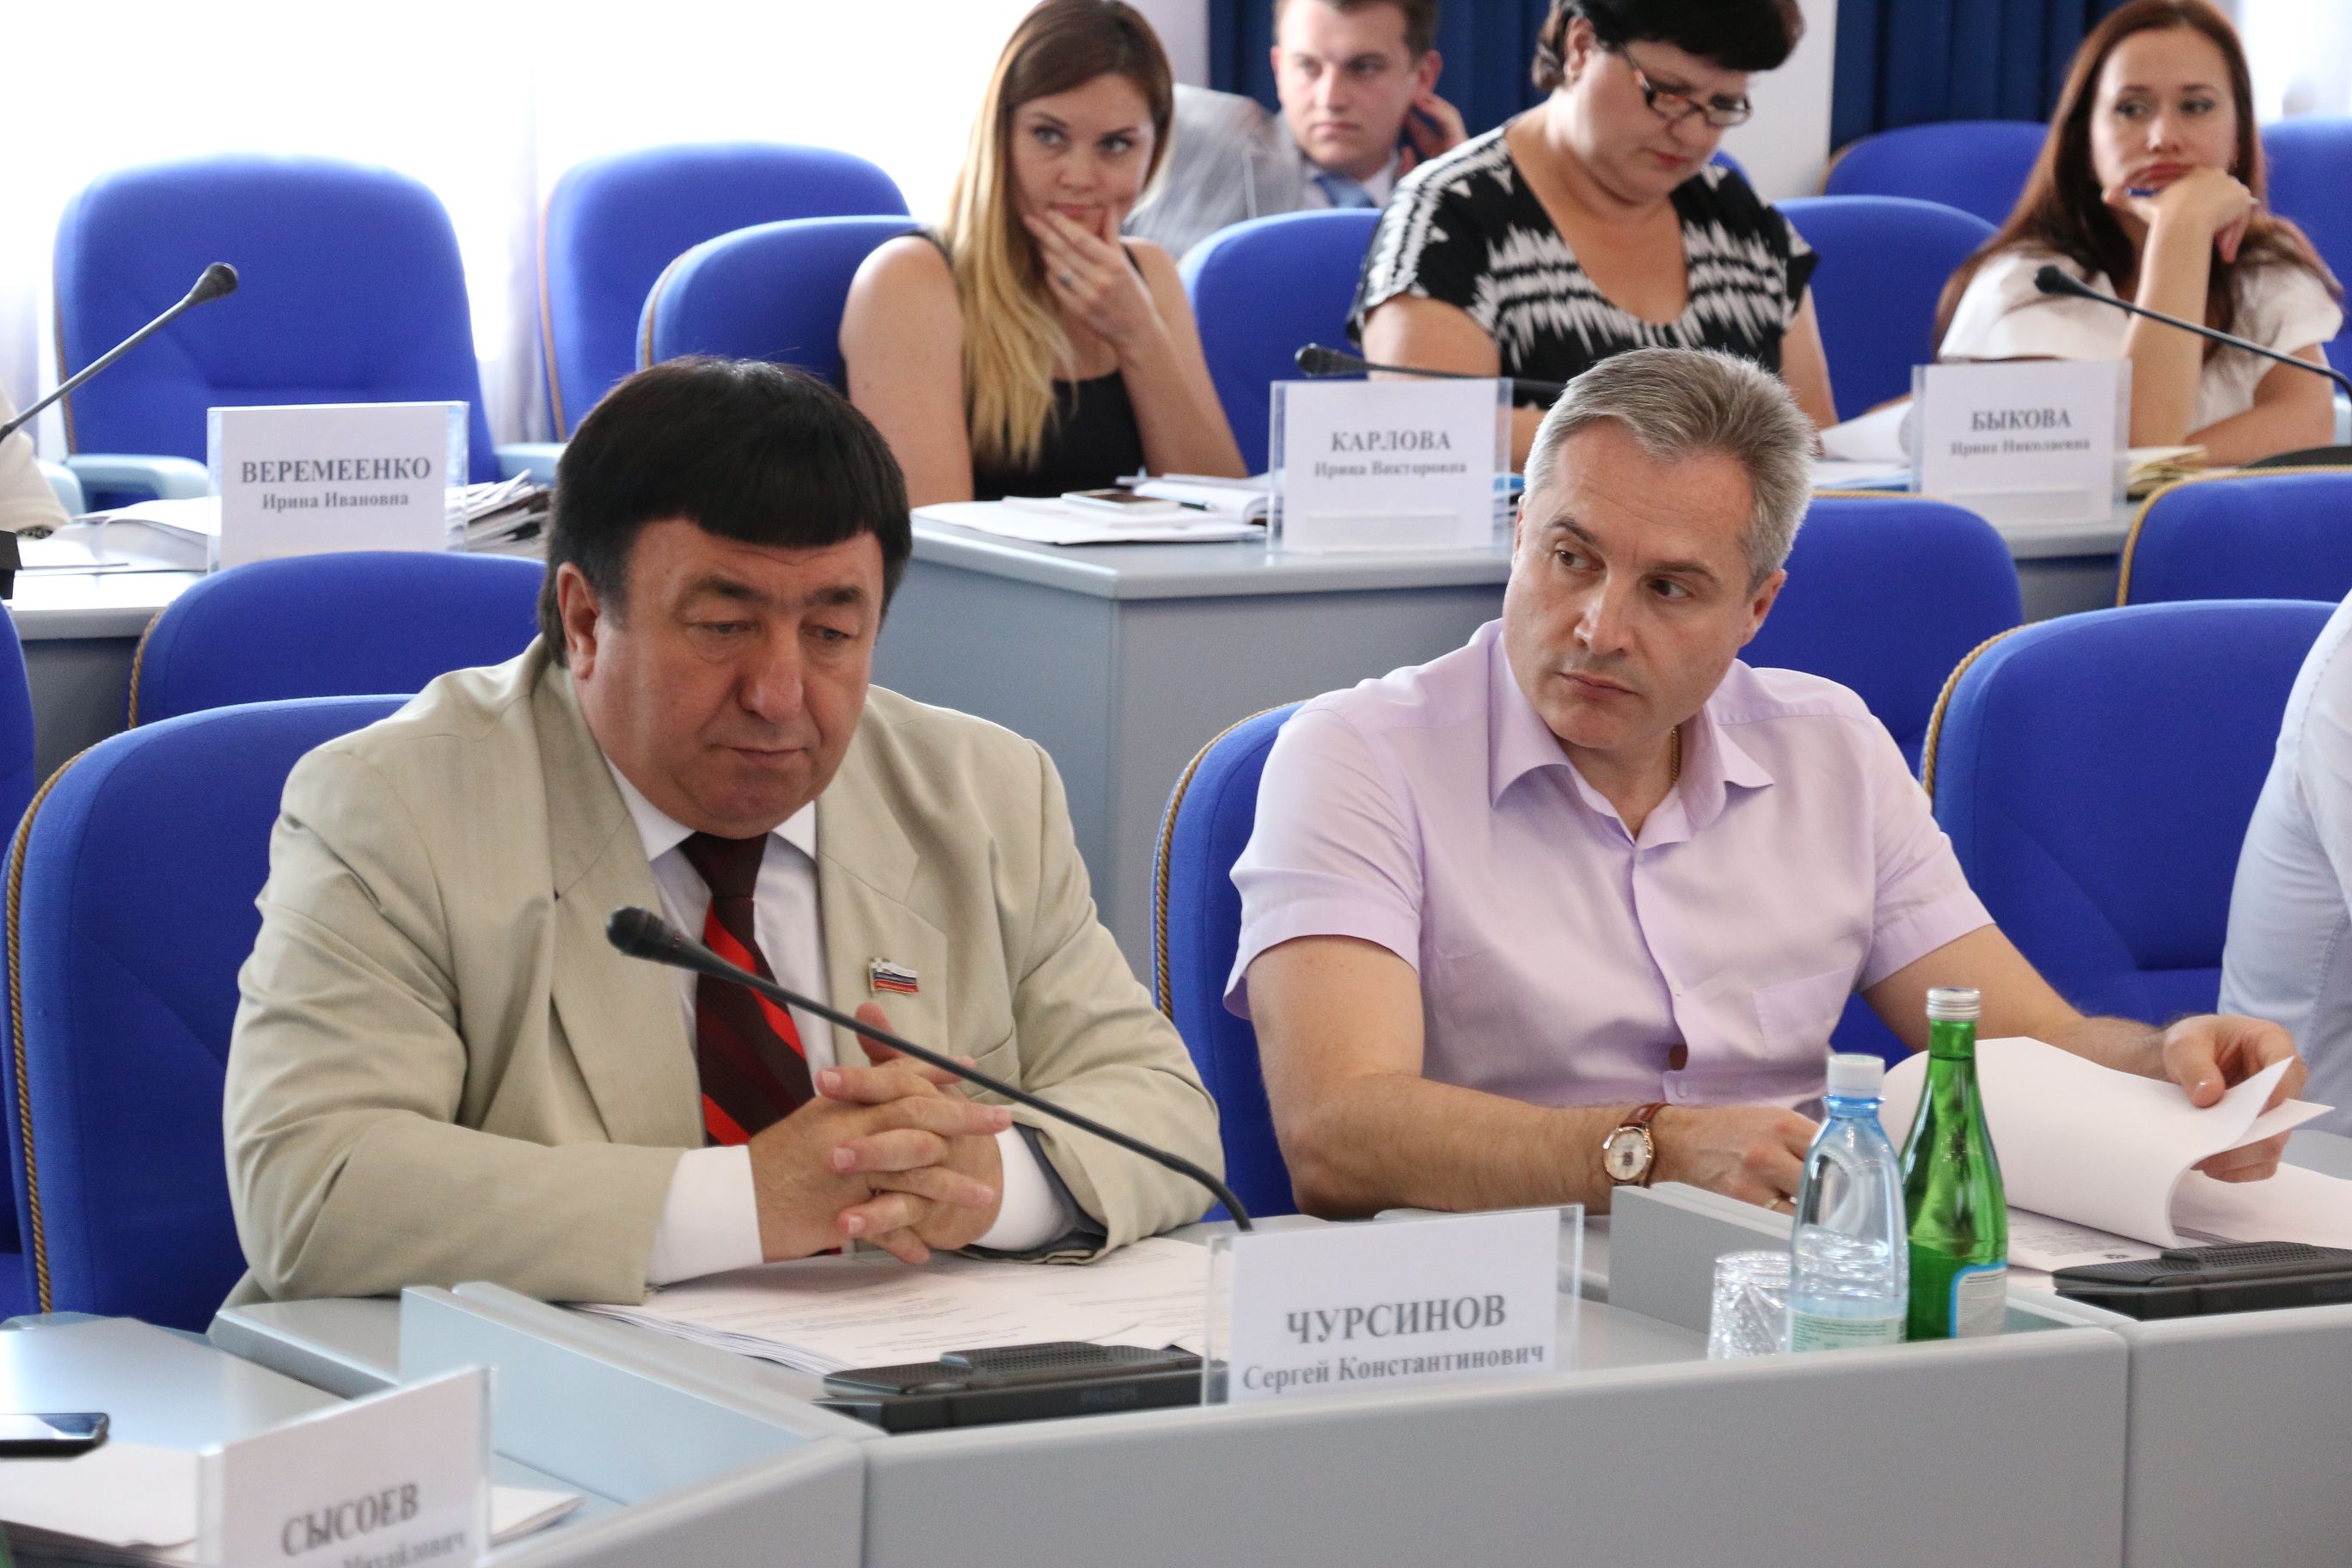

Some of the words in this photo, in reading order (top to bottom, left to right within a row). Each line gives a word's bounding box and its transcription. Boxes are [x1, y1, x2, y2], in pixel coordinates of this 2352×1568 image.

[1971, 407, 2072, 432] БЫКОВА
[1331, 430, 1452, 452] КАРЛОВА
[242, 456, 432, 483] ВЕРЕМЕЕНКО
[262, 493, 319, 513] Ирина
[324, 491, 409, 508] Ивановна
[1286, 1294, 1506, 1344] ЧУРСИНОВ
[1242, 1357, 1330, 1394] Сергей
[1338, 1344, 1545, 1382] Константинович
[280, 1482, 420, 1557] СЫСОЕВ
